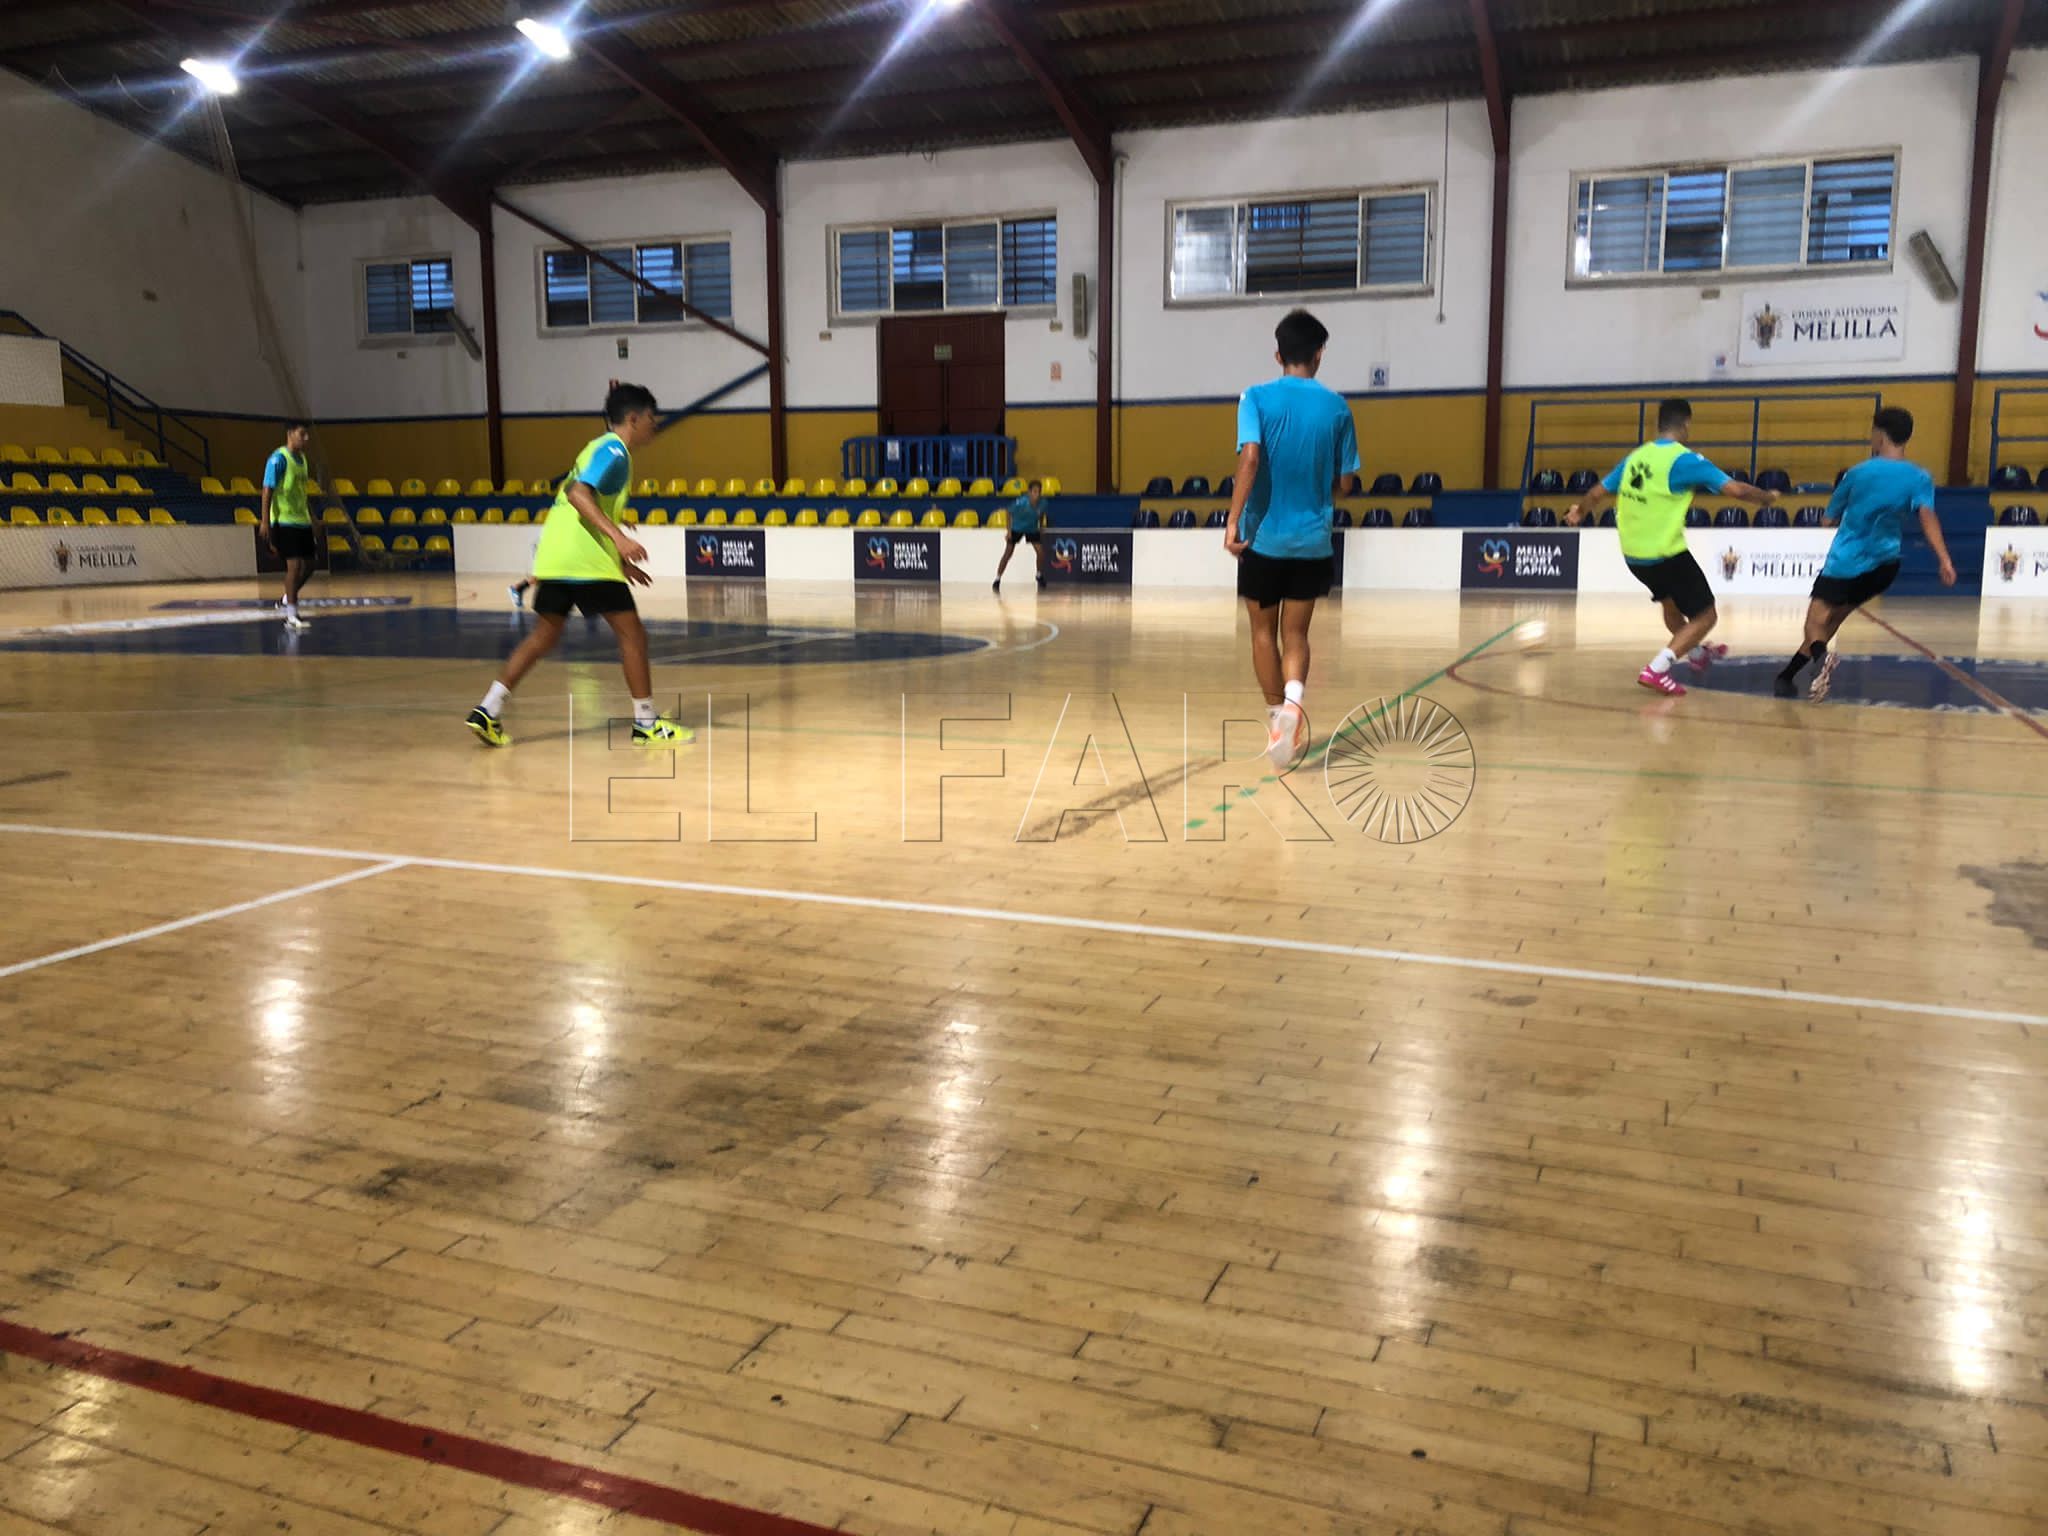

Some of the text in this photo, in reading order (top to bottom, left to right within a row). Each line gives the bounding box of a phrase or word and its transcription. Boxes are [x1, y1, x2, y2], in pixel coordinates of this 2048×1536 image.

[1794, 318, 1897, 342] MELILLA
[1515, 545, 1561, 556] MELILLA
[79, 552, 137, 568] MELILLA
[1515, 555, 1550, 566] SPORT
[1515, 565, 1561, 576] CAPITAL
[1752, 562, 1821, 577] MELILL
